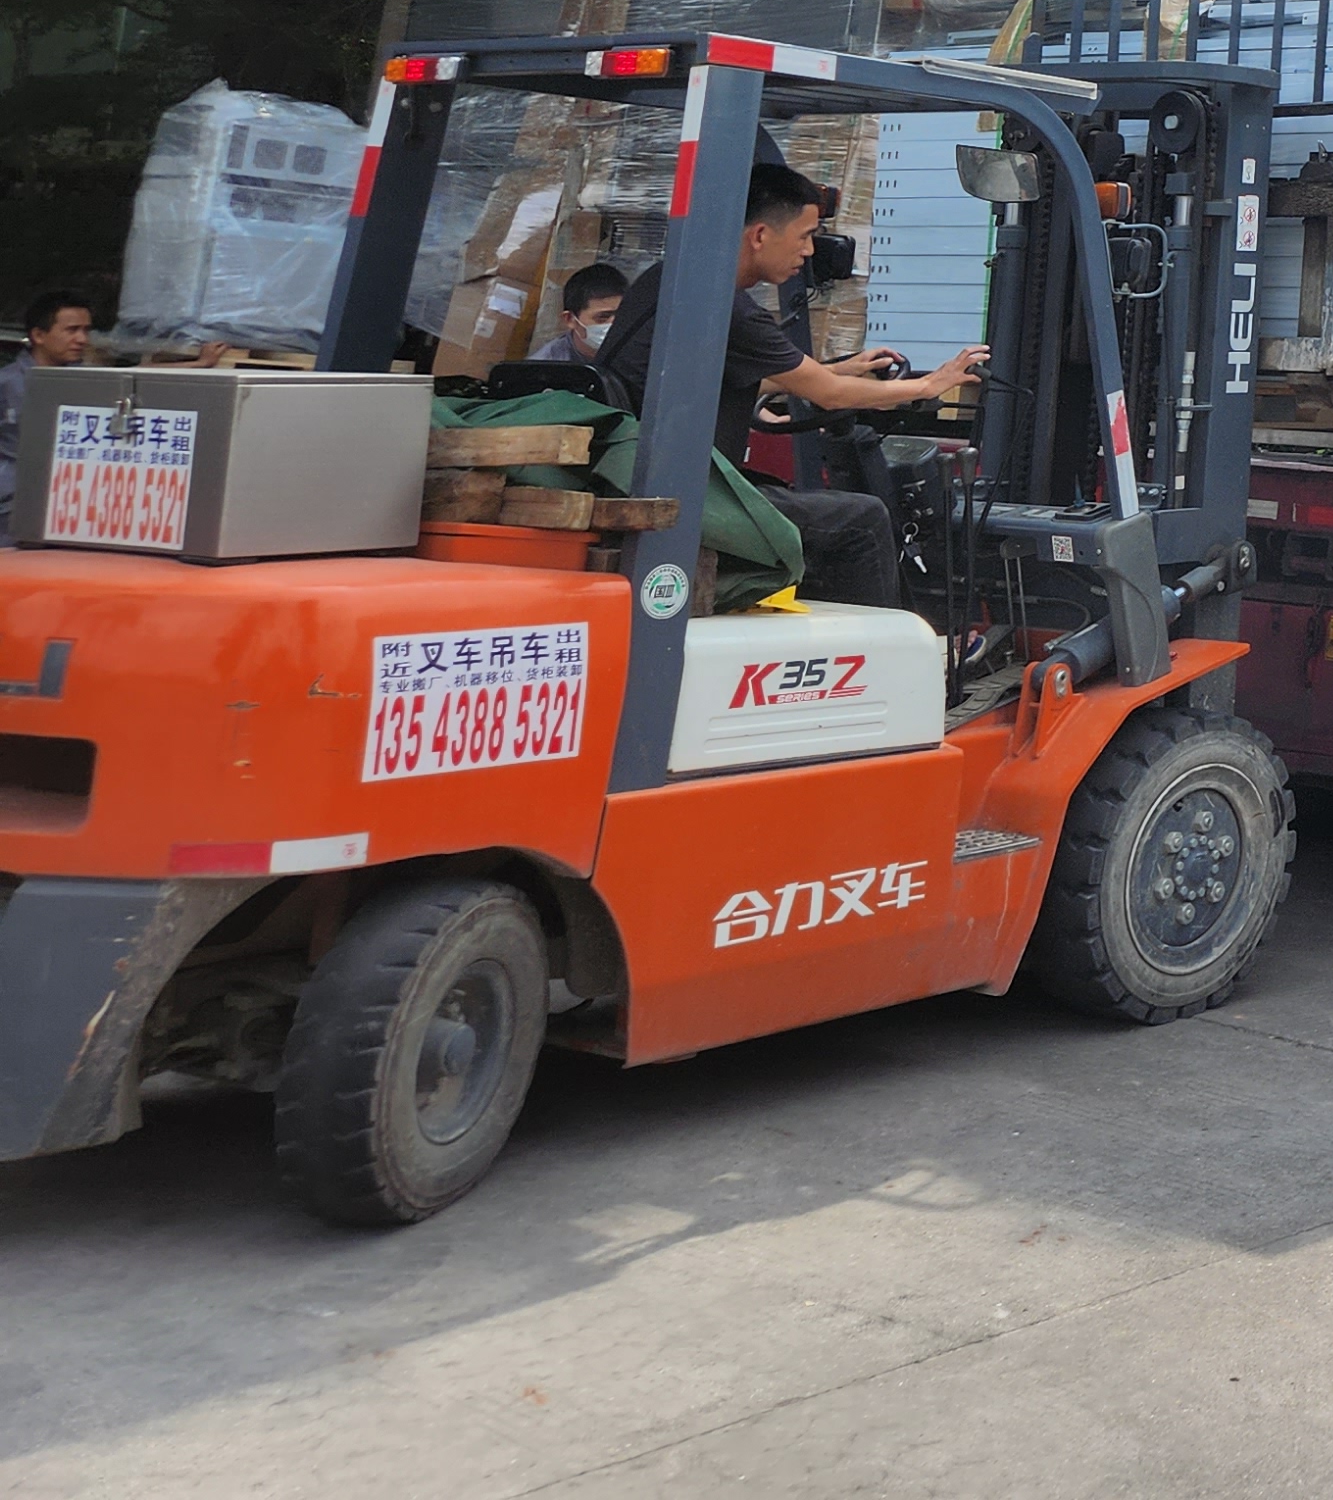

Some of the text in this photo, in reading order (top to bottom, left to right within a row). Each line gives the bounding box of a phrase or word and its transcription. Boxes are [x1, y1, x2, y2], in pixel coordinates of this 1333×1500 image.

[1225, 263, 1257, 393] HELI
[51, 461, 189, 545] 135 4388 5321
[416, 632, 550, 674] 叉车吊车
[373, 678, 582, 775] 135 4388 5321
[712, 860, 929, 948] 合力叉车
